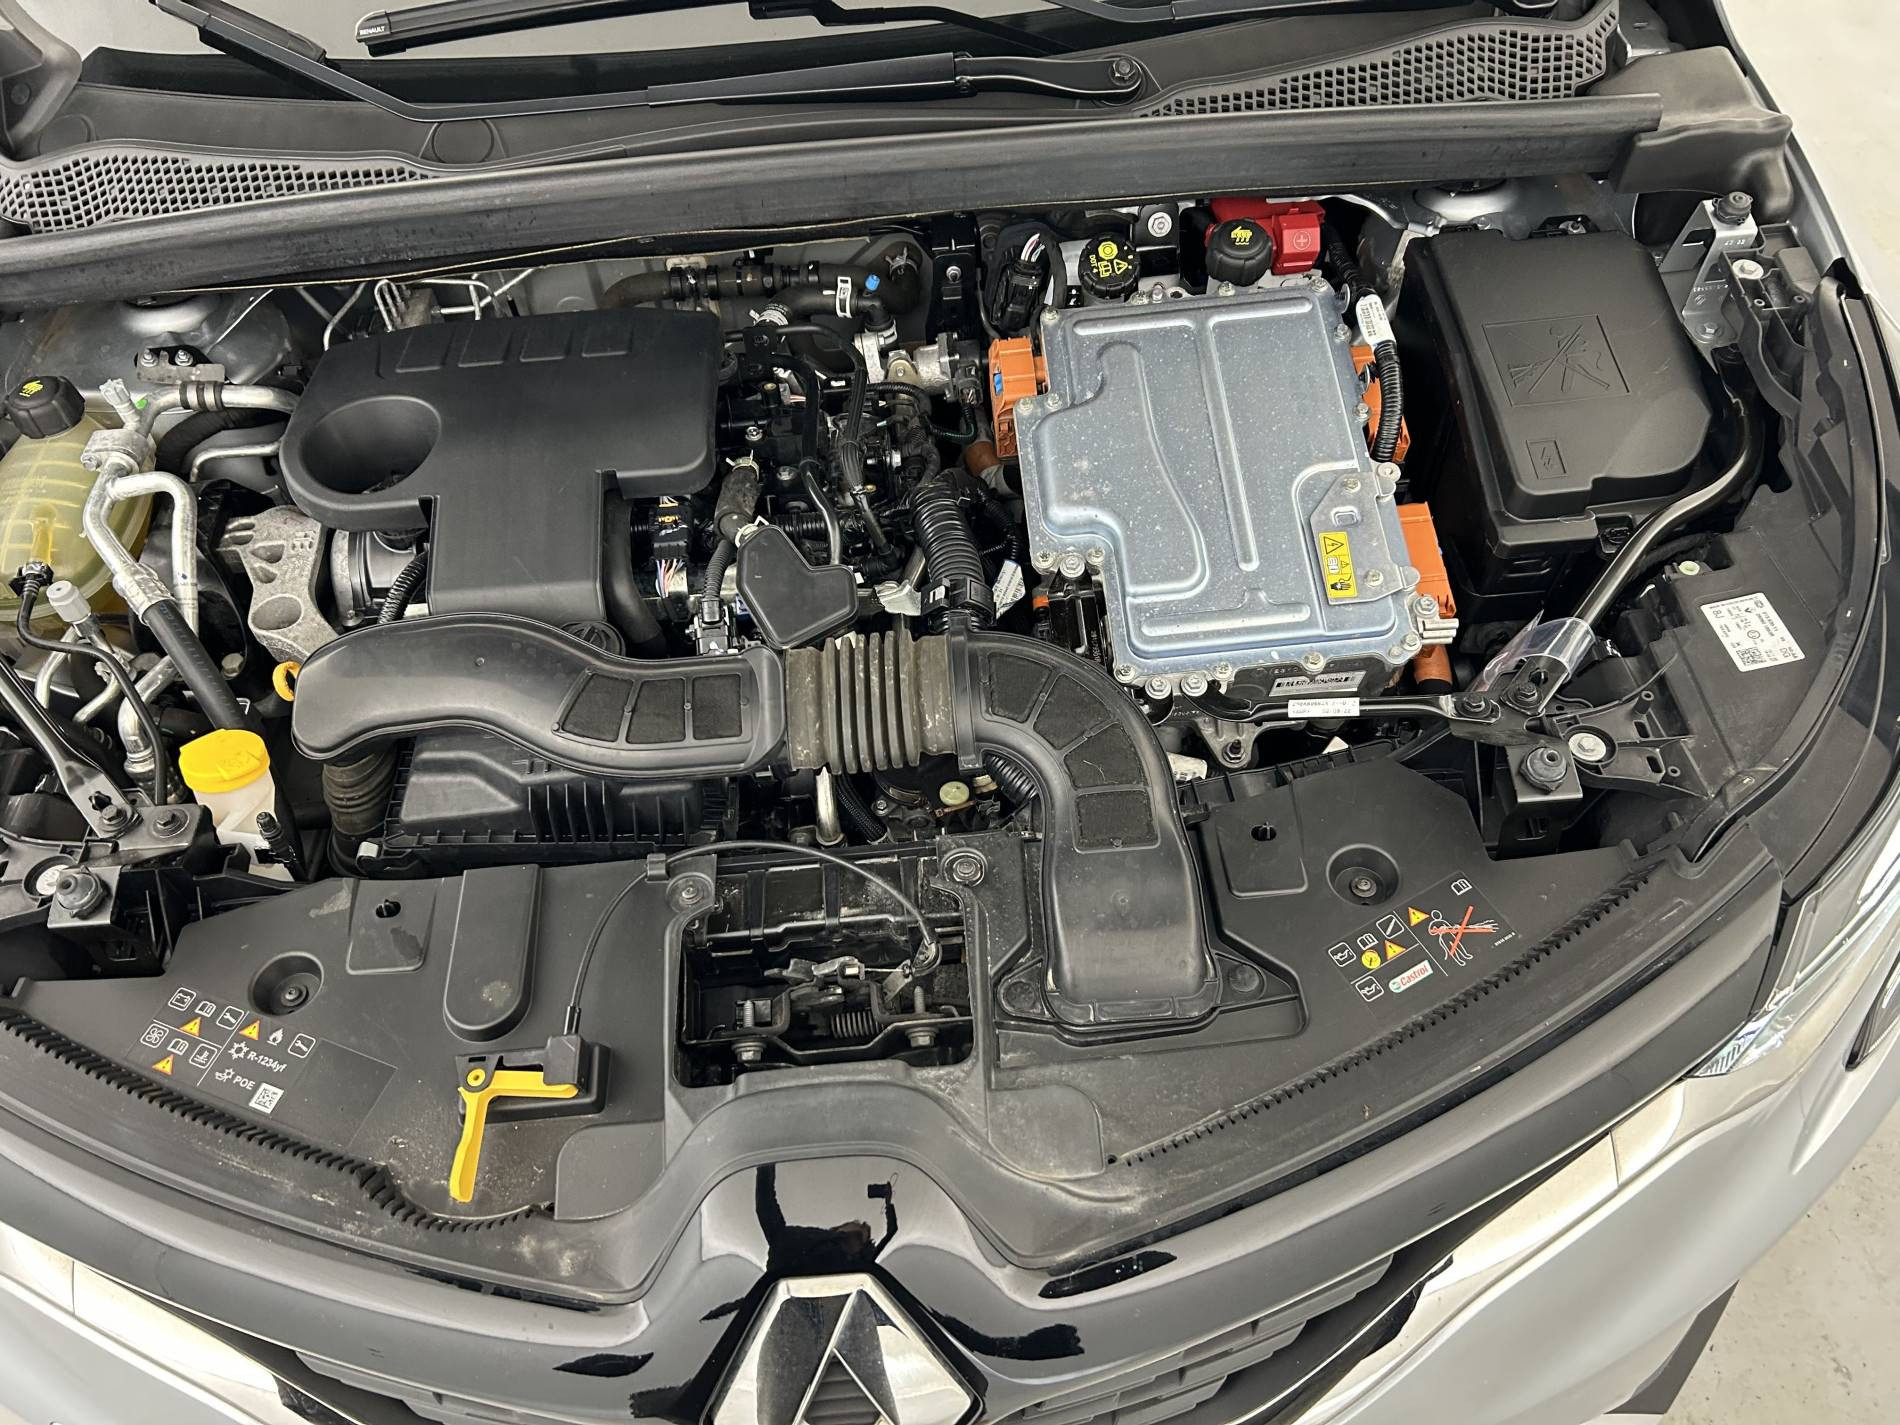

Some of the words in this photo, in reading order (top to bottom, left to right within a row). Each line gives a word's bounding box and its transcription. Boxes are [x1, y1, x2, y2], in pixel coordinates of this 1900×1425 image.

[1400, 965, 1429, 987] Castrol
[247, 1050, 288, 1073] R-1234yf
[233, 1075, 256, 1090] POE
